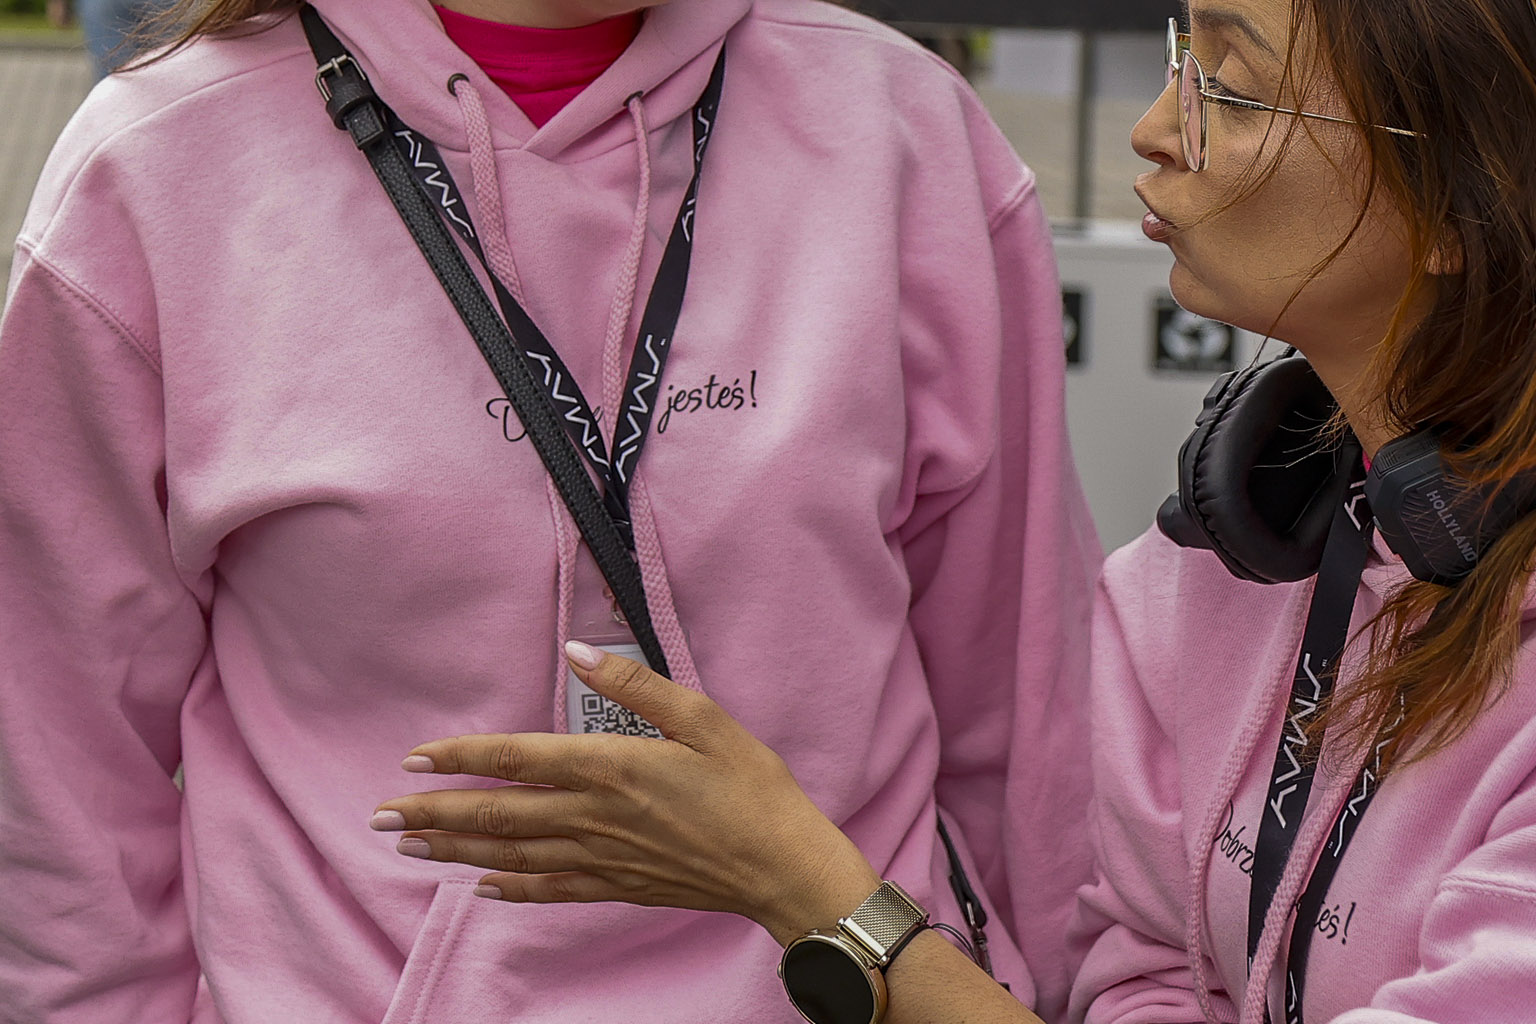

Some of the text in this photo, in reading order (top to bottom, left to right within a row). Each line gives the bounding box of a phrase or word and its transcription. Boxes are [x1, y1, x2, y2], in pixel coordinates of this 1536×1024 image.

[657, 370, 757, 434] jesteś!
[1425, 489, 1478, 562] HOLLYLAND
[1214, 799, 1254, 874] obrz
